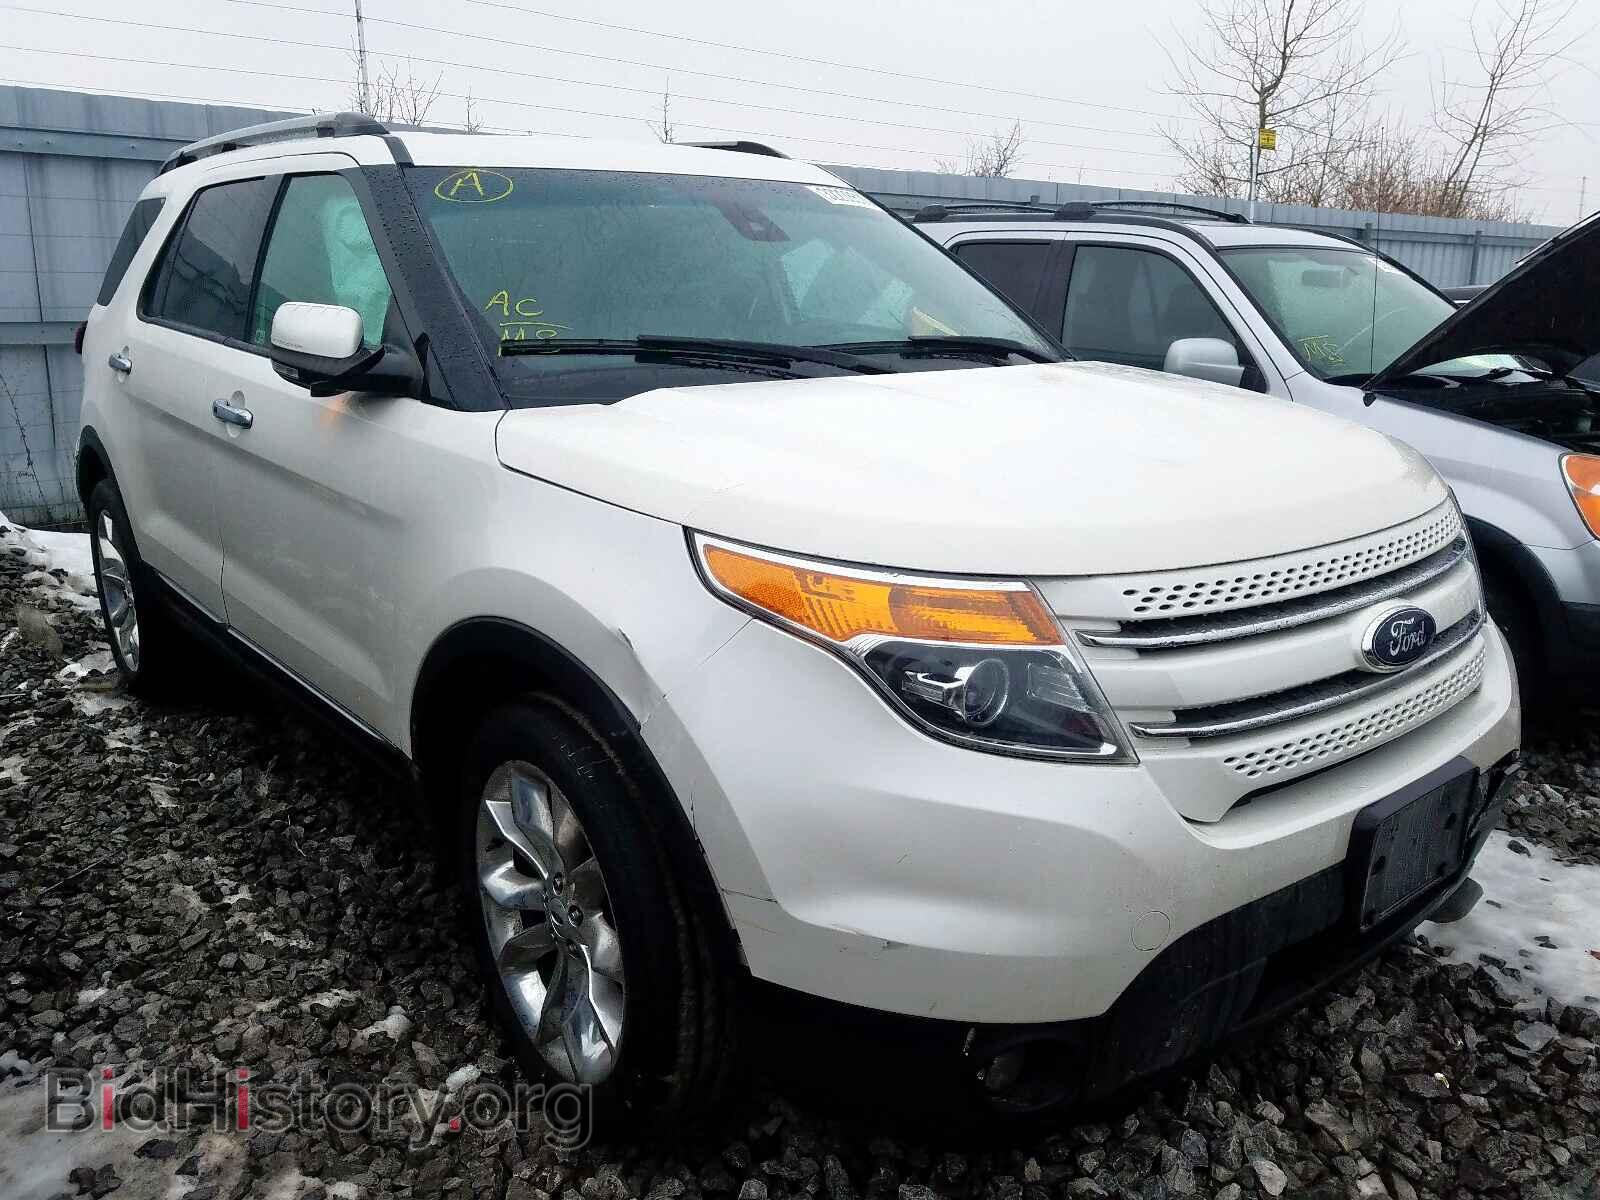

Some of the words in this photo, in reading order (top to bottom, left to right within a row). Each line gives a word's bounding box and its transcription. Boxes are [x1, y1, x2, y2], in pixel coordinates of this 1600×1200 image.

[450, 169, 484, 196] A
[485, 290, 544, 317] AC
[1389, 617, 1427, 657] Ford
